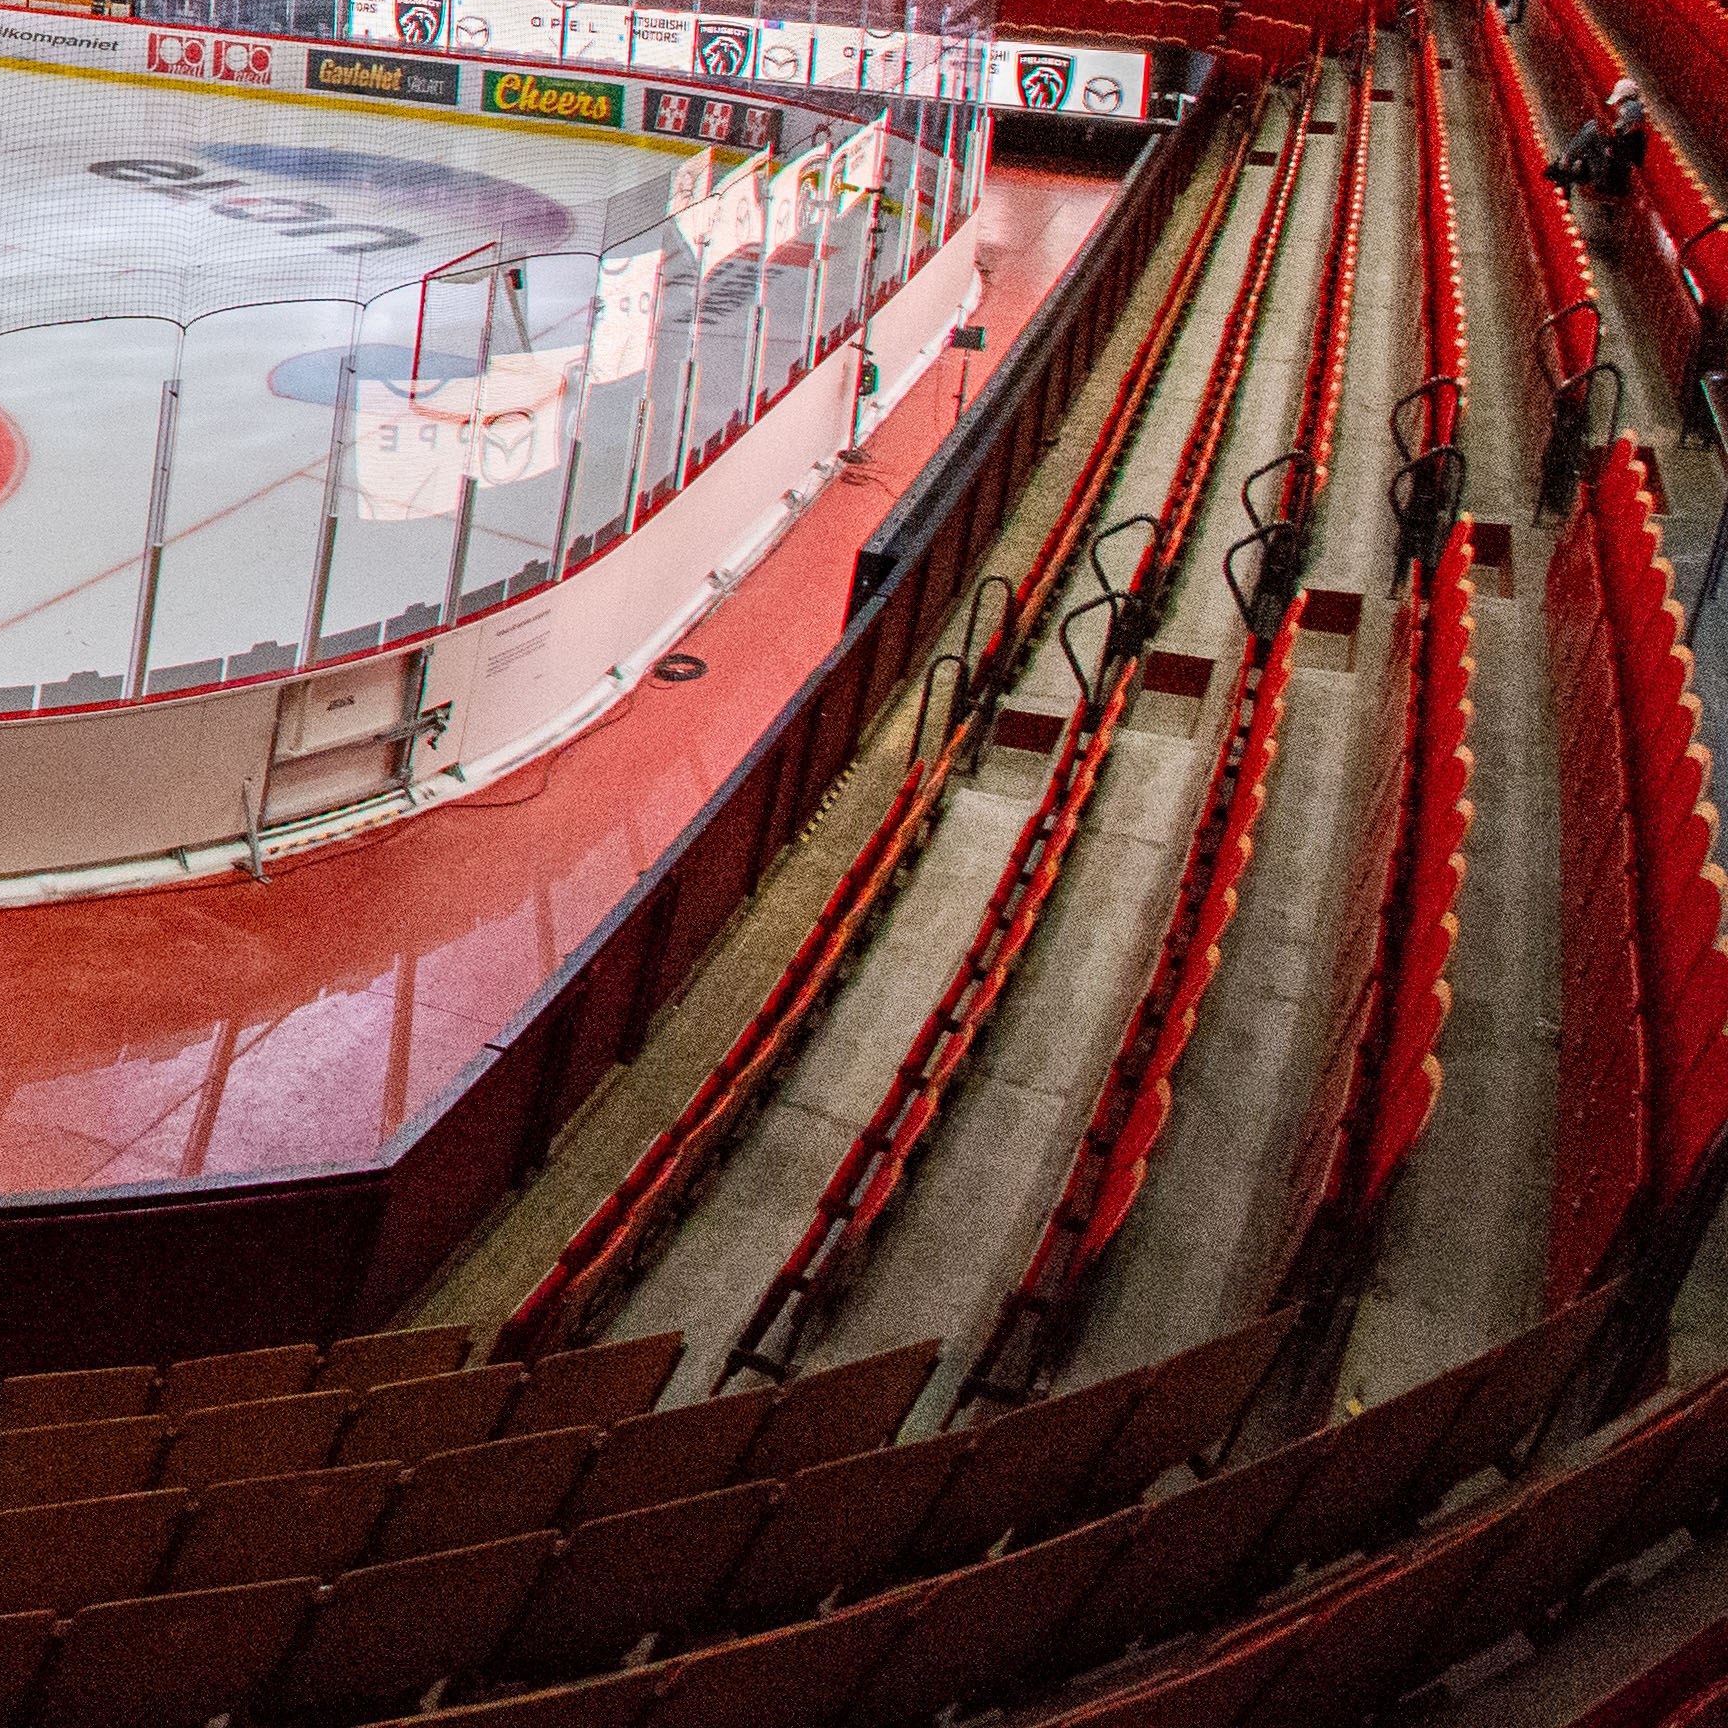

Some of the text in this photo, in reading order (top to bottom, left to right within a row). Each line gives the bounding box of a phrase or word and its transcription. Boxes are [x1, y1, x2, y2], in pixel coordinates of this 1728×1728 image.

[632, 29, 679, 43] MOTORS
[699, 25, 749, 38] PEUGEOT
[1019, 56, 1071, 71] PEUGEOT
[495, 72, 612, 120] Cheers
